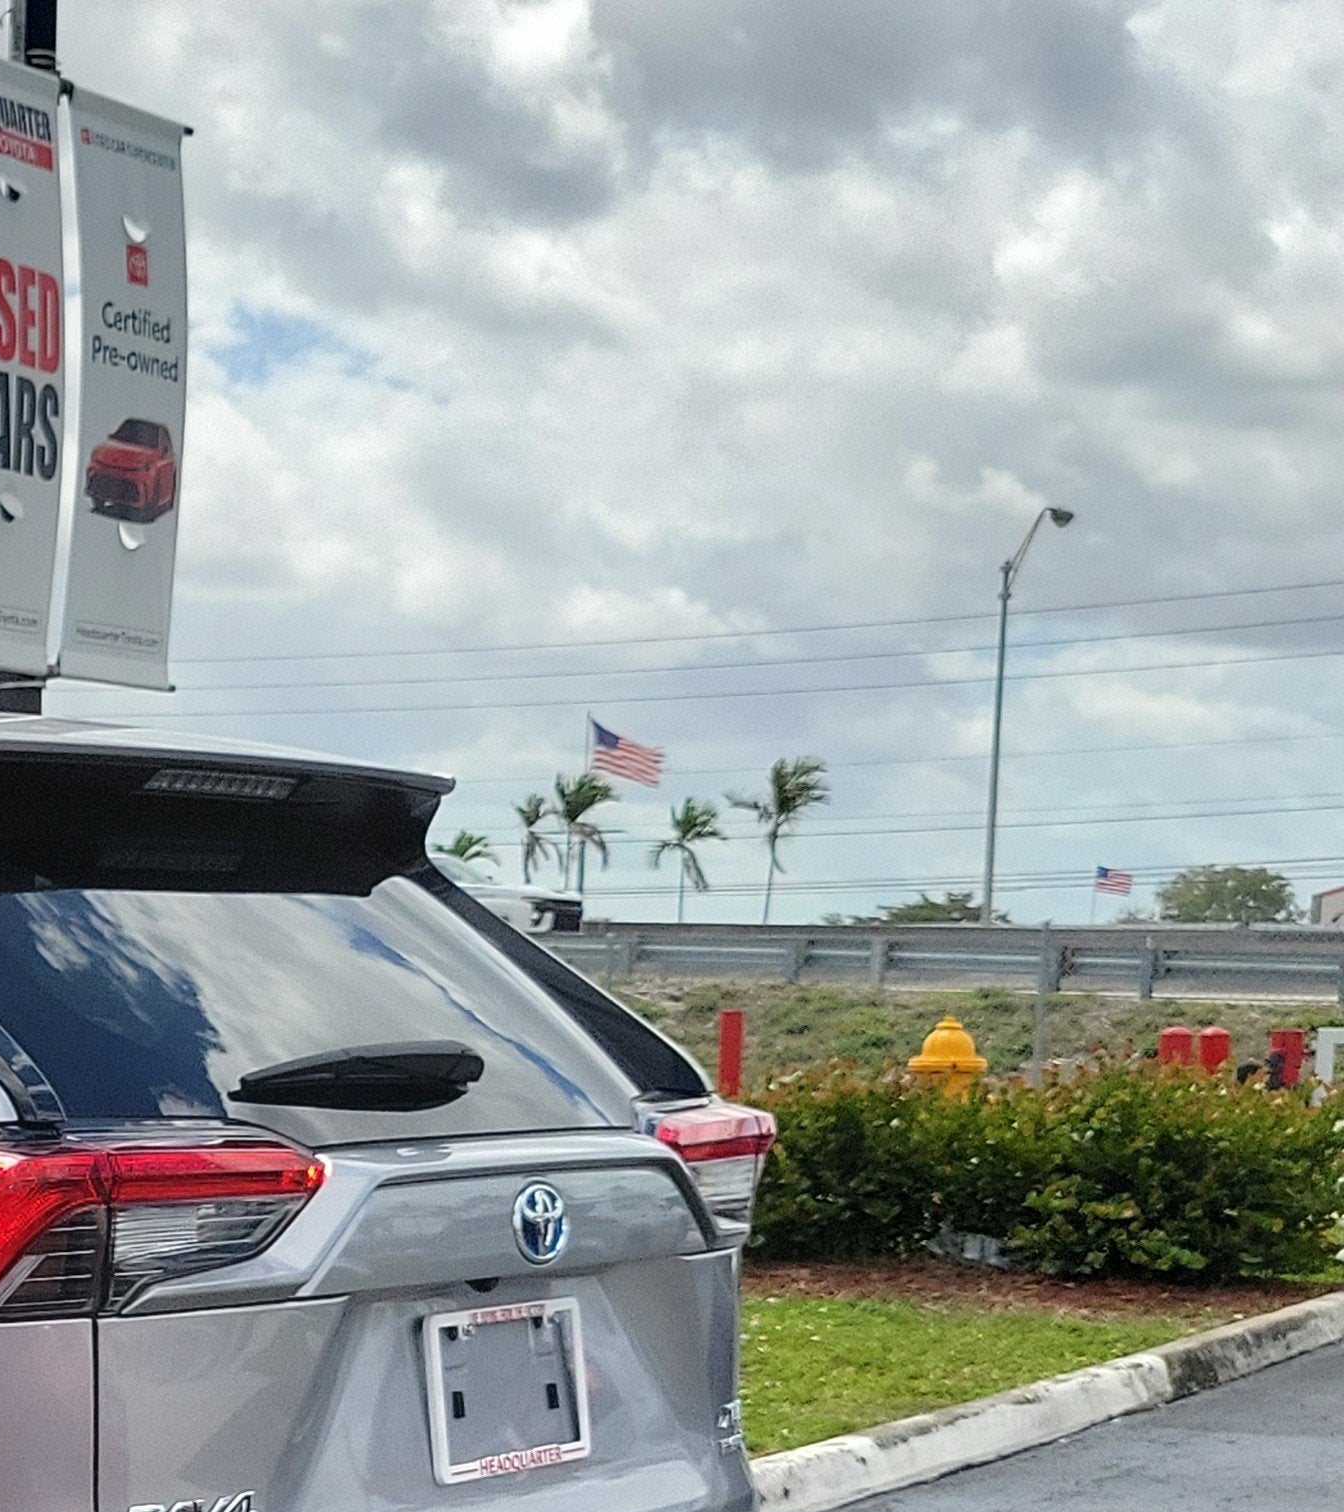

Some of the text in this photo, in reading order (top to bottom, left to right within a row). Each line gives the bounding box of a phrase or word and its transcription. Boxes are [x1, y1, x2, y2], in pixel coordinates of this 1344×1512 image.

[101, 301, 172, 344] Certified
[91, 335, 179, 383] Pre-owned
[480, 1446, 562, 1476] HEADQUARTER
